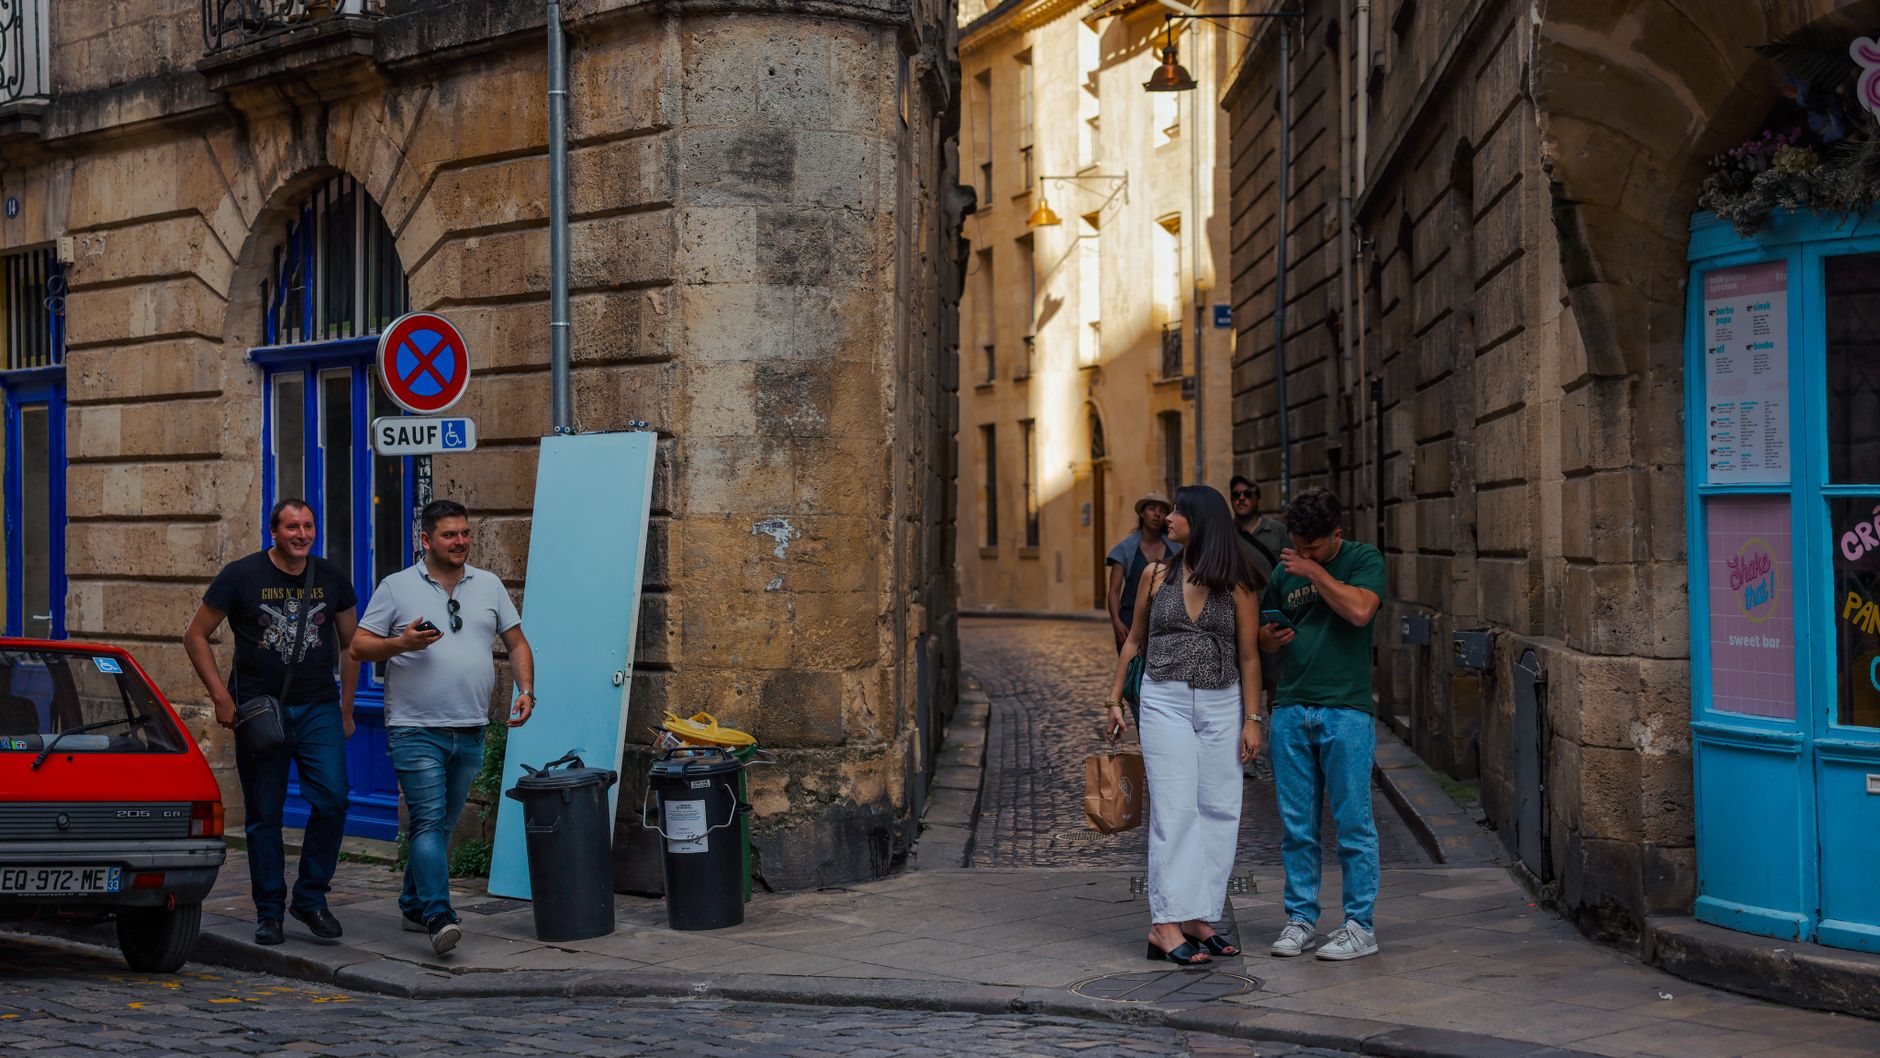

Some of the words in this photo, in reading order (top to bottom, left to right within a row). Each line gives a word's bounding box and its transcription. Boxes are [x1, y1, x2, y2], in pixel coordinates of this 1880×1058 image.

[8, 200, 16, 215] 14
[382, 425, 438, 446] SAUF
[1841, 505, 1880, 561] CR
[1727, 552, 1771, 591] Shake
[261, 588, 284, 600] GUNS
[296, 587, 324, 599] RES
[1728, 635, 1761, 648] sweet
[1762, 634, 1782, 649] bar
[116, 810, 150, 818] 205
[2, 869, 105, 890] EQ-972-ME
[107, 880, 119, 890] 33
